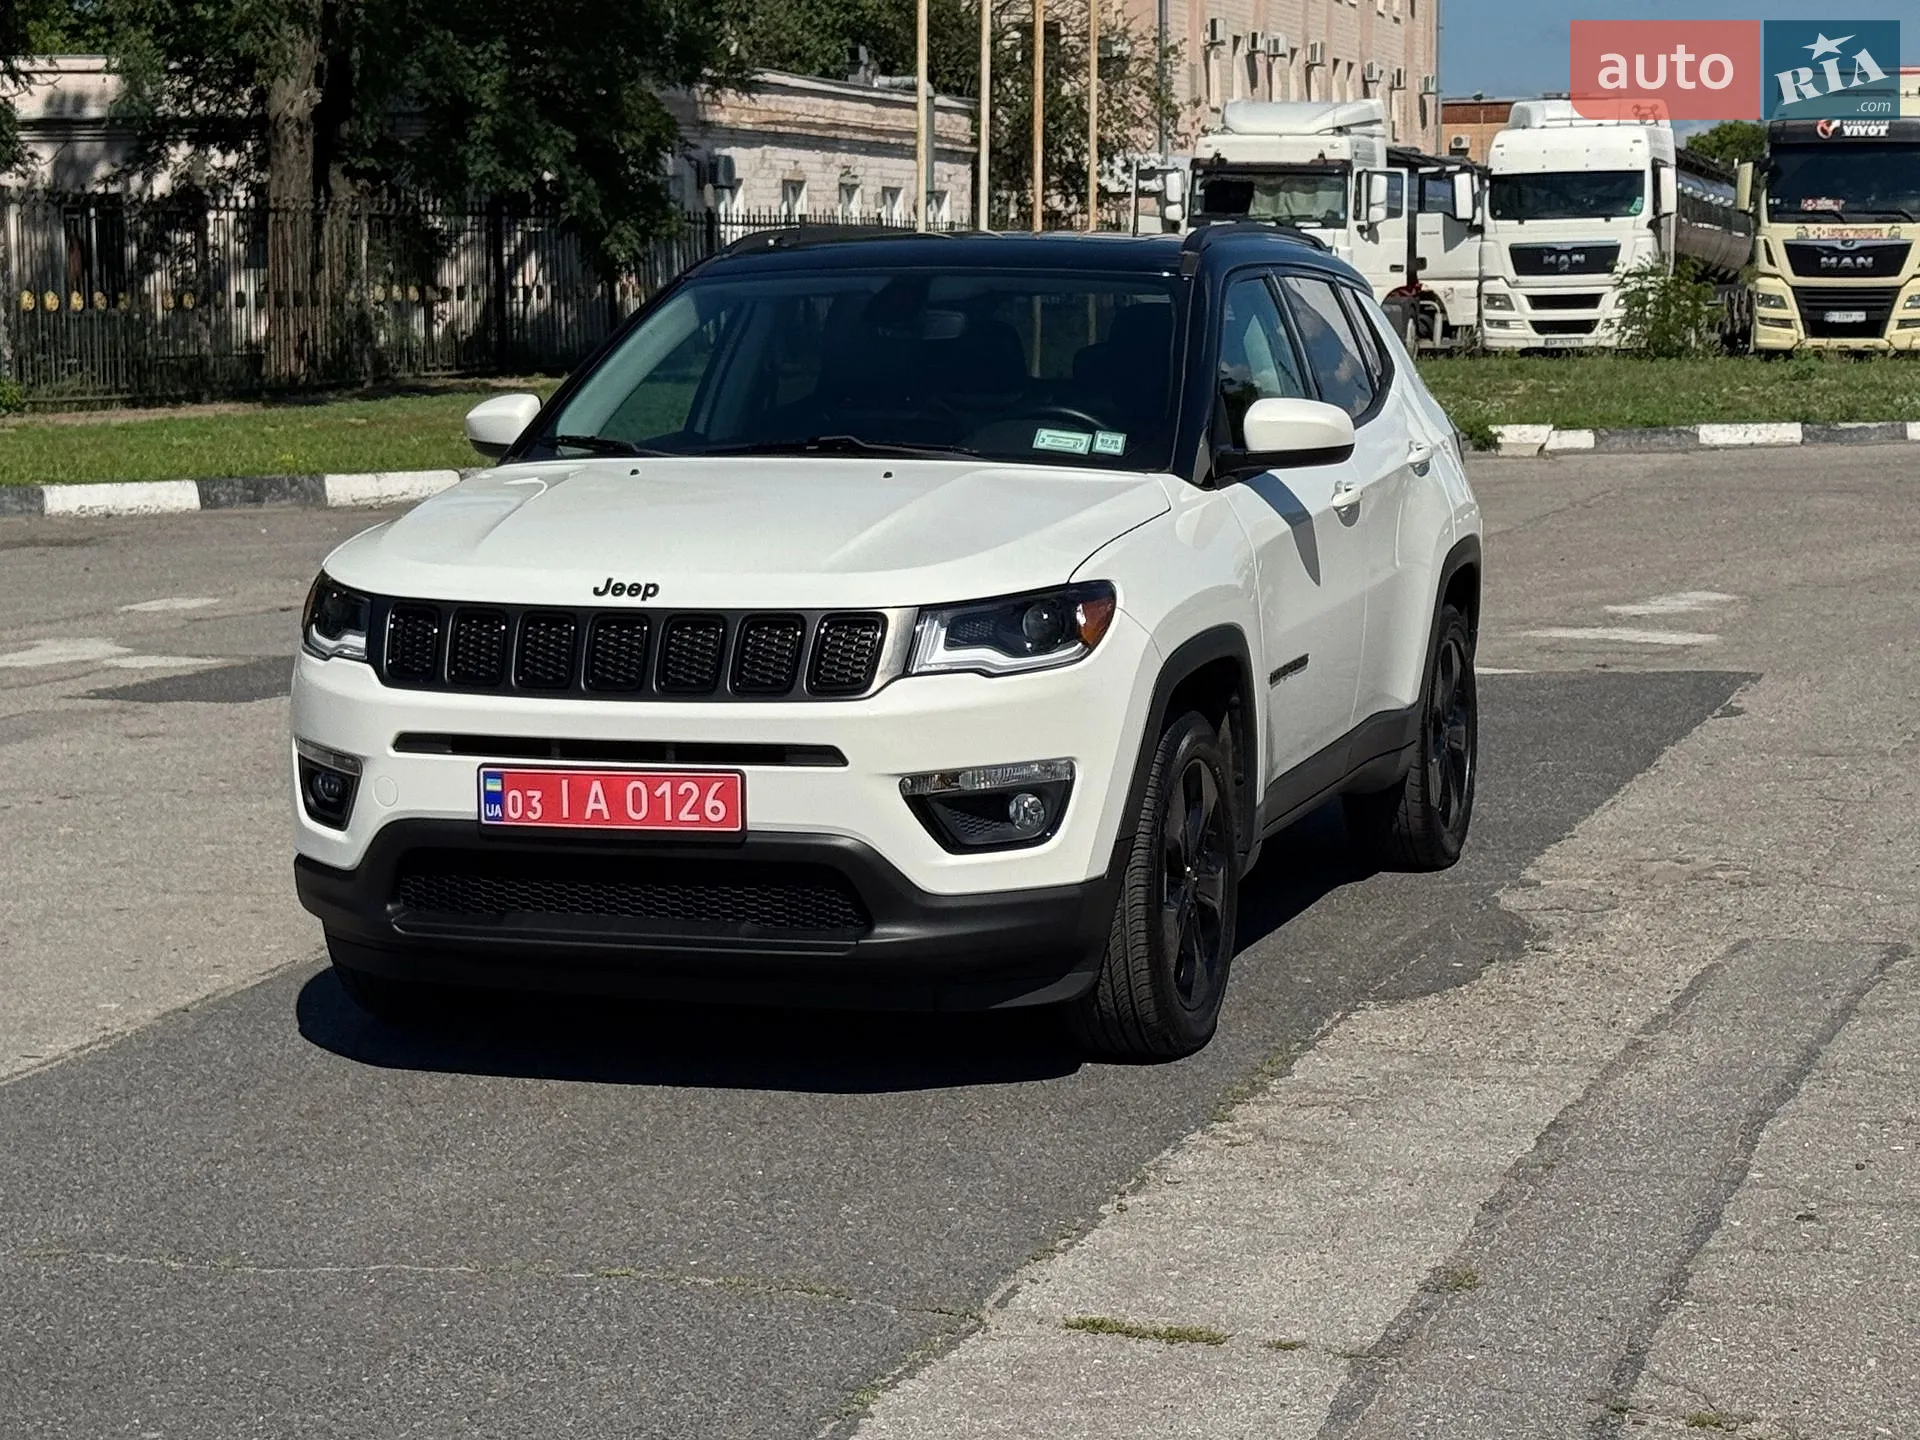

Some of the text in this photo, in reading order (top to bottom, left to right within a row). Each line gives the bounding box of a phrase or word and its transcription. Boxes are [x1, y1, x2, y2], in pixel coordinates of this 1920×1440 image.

[1543, 254, 1585, 265] MAN
[1820, 256, 1873, 268] MAN
[593, 577, 660, 601] Jeep
[507, 789, 543, 820] 03
[625, 780, 728, 822] 0126
[486, 803, 503, 817] UA
